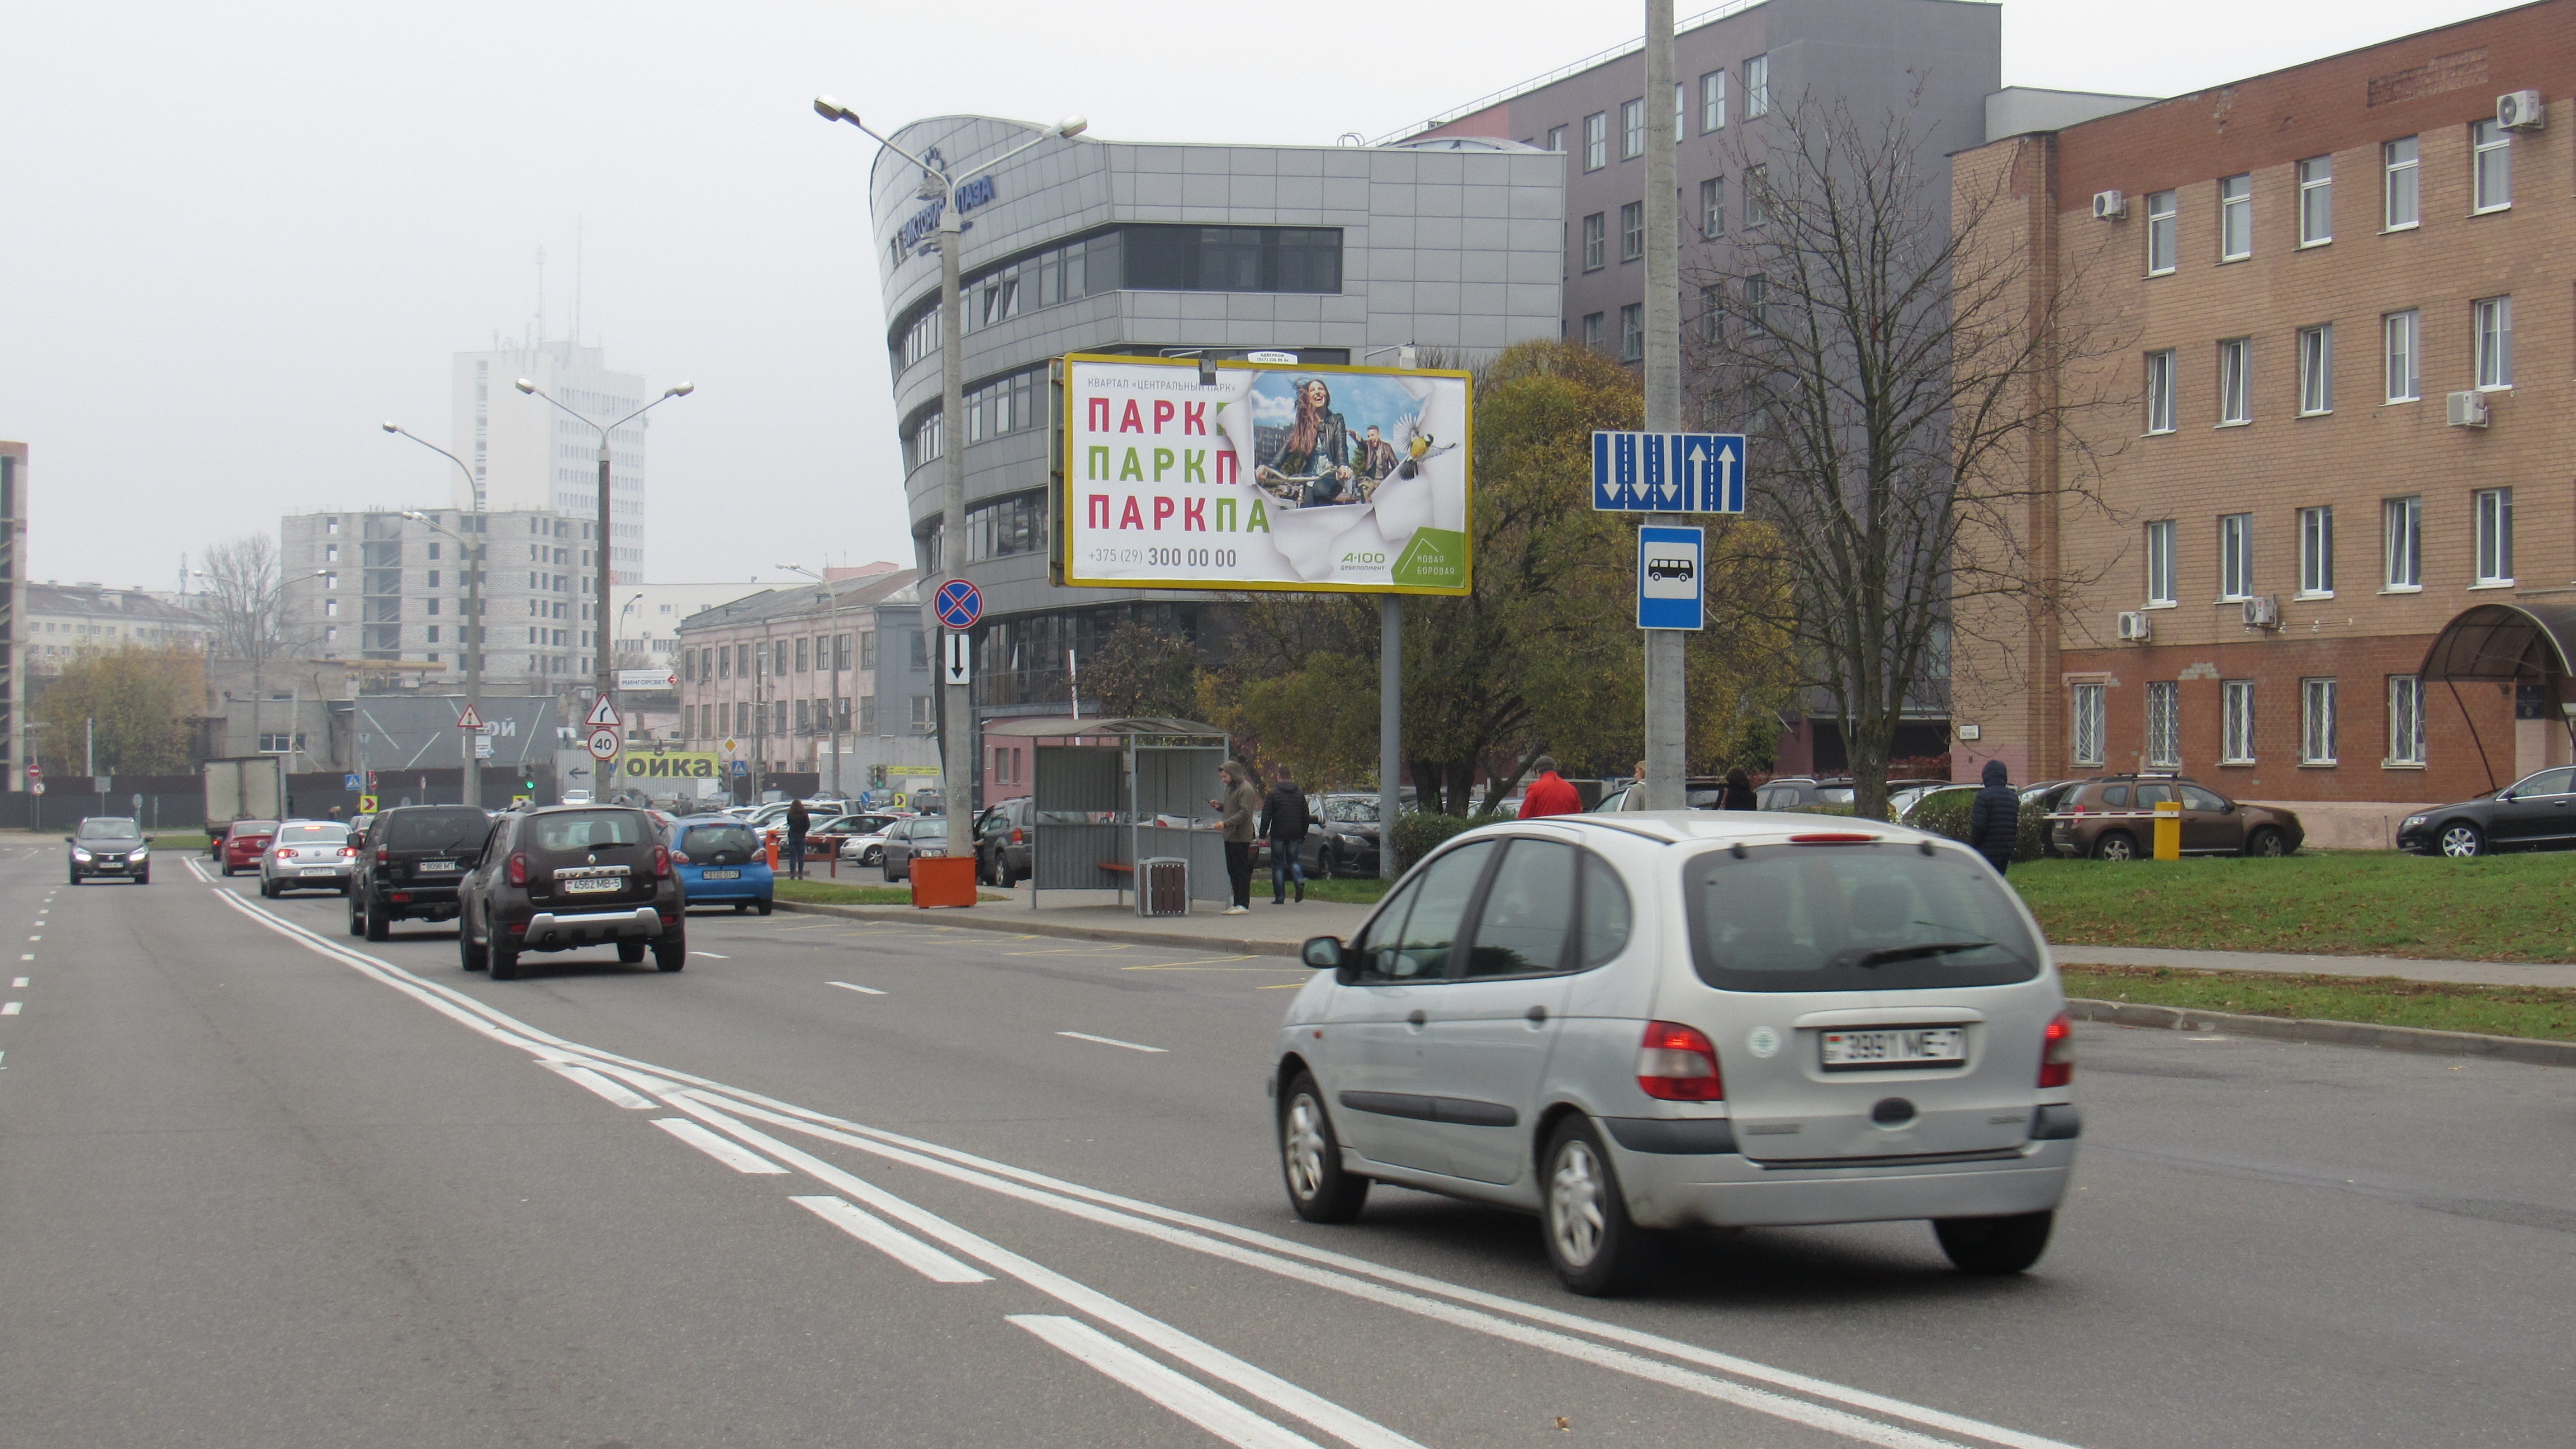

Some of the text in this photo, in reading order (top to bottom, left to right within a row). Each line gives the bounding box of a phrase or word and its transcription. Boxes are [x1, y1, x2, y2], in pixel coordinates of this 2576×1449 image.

[955, 175, 995, 215] ЛАЗА
[1088, 378, 1129, 389] КВАРТАЛ
[1089, 547, 1237, 567] +375 (29) 300 00 00
[595, 738, 612, 750] 40
[614, 748, 712, 776] ойка
[574, 878, 620, 889] 4562 MB-5
